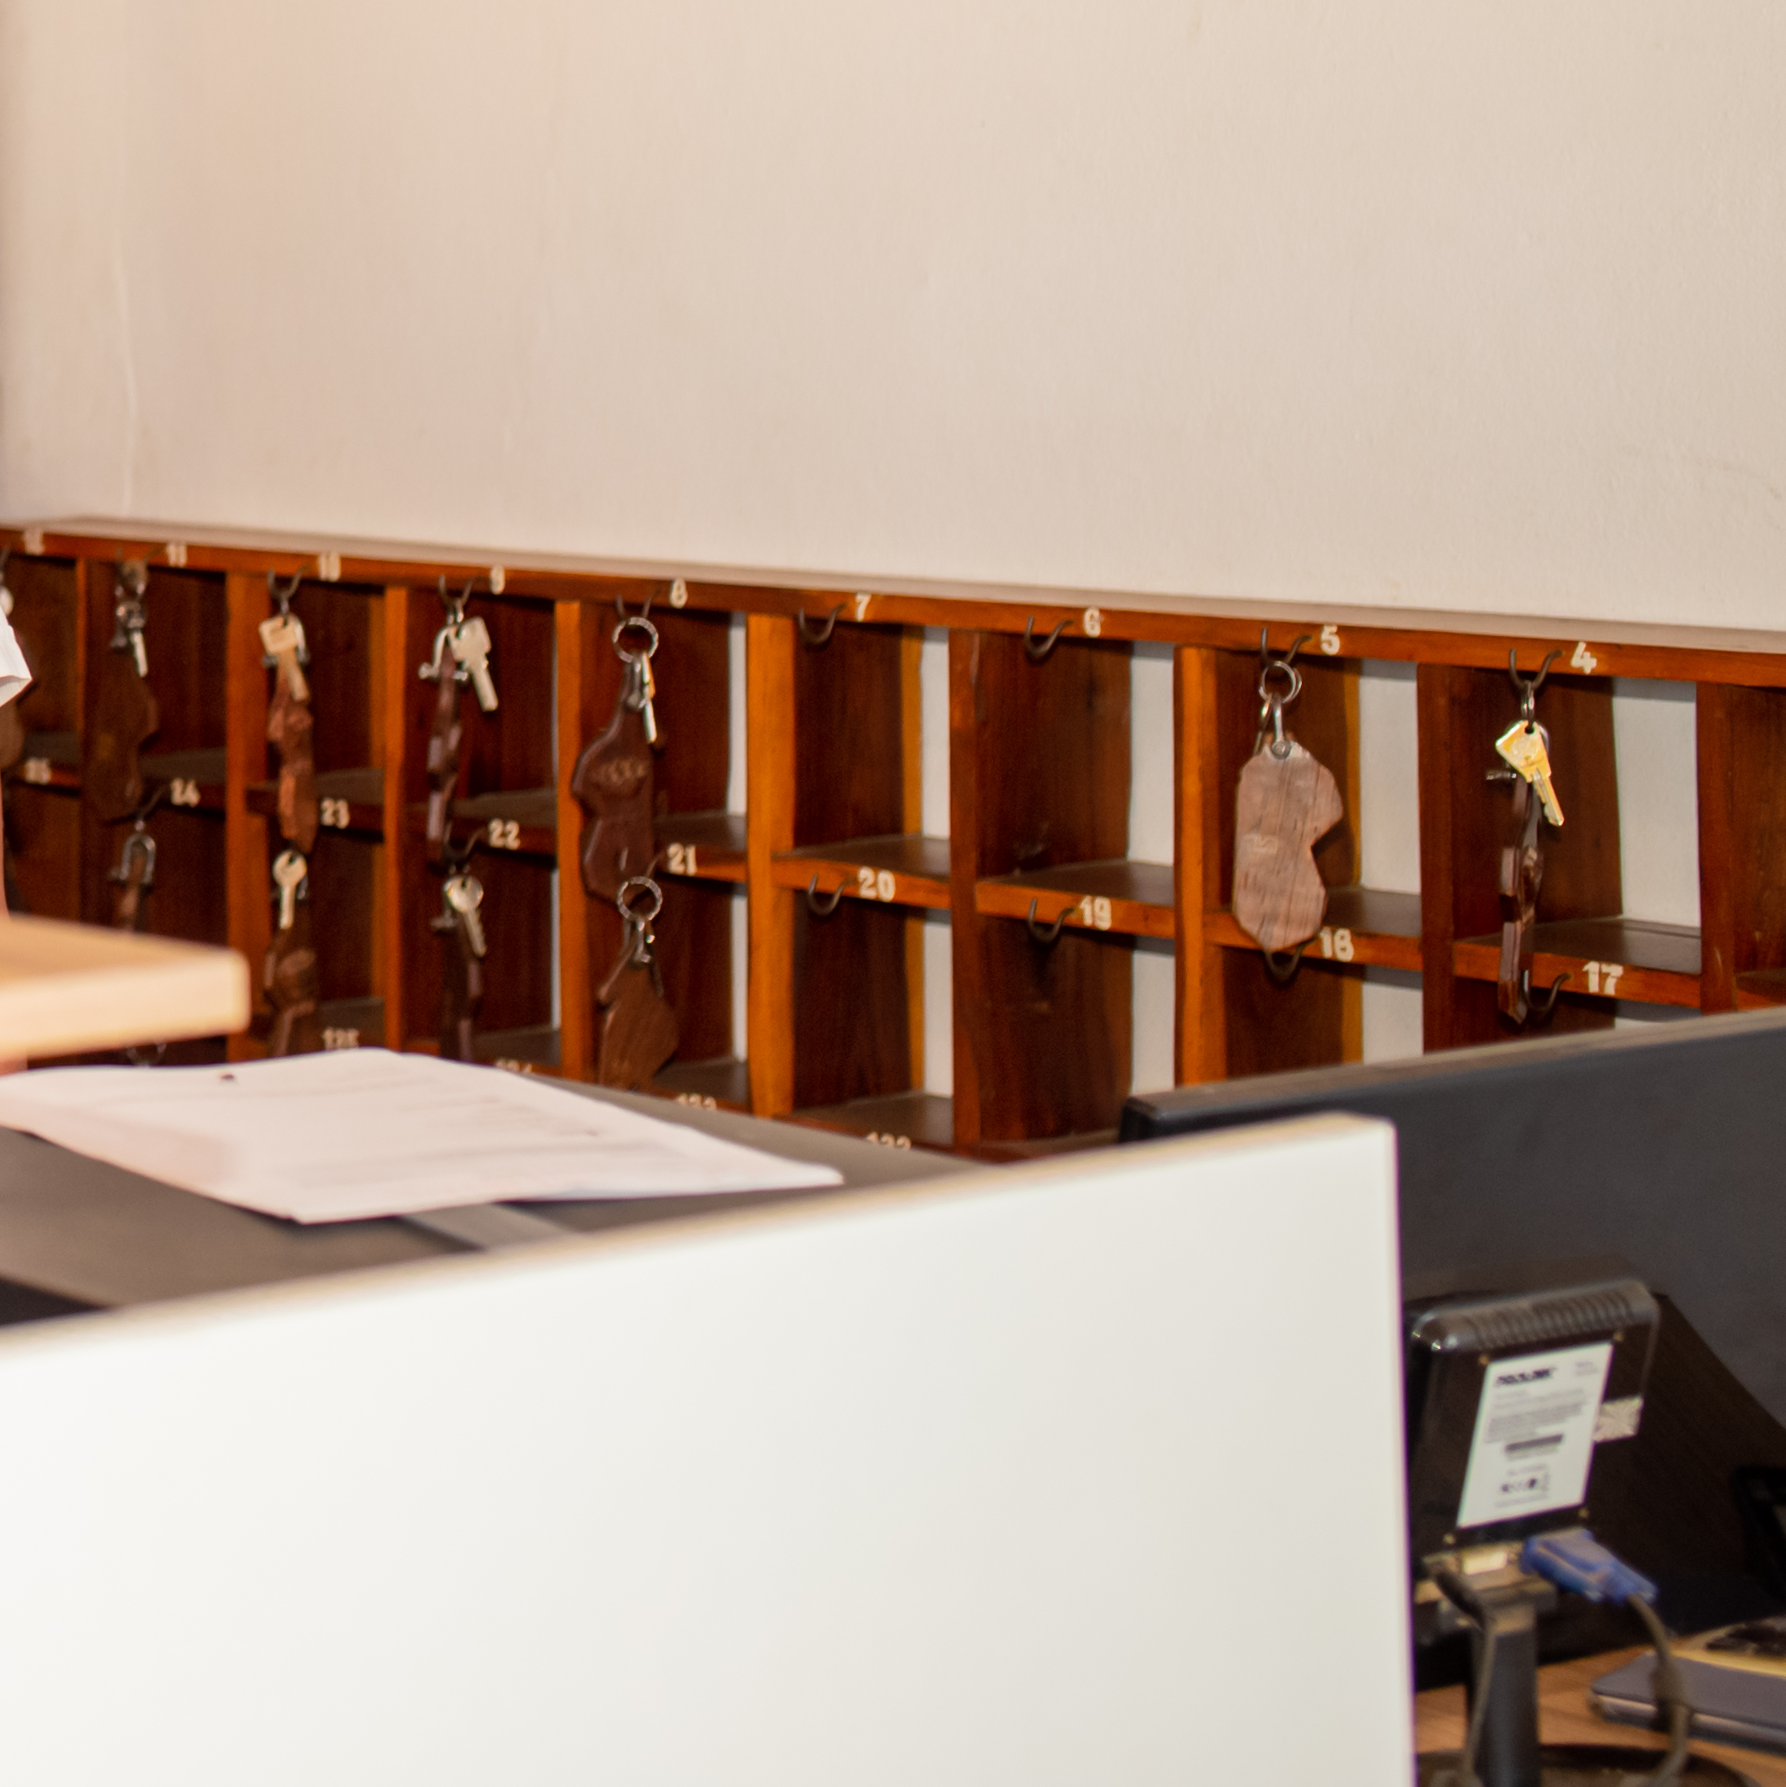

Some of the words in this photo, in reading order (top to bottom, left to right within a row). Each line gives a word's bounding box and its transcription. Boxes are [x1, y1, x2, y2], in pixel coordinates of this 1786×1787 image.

[669, 576, 688, 609] 8
[854, 592, 872, 622] 7
[1082, 607, 1103, 638] 6
[1320, 624, 1340, 656] 5
[1570, 641, 1598, 674] 4
[320, 797, 350, 829] 23
[488, 818, 521, 850] 22
[667, 842, 698, 876] 21
[857, 866, 896, 903] 20
[1079, 896, 1112, 930] 19
[1319, 927, 1355, 962] 18
[1582, 960, 1624, 996] 17
